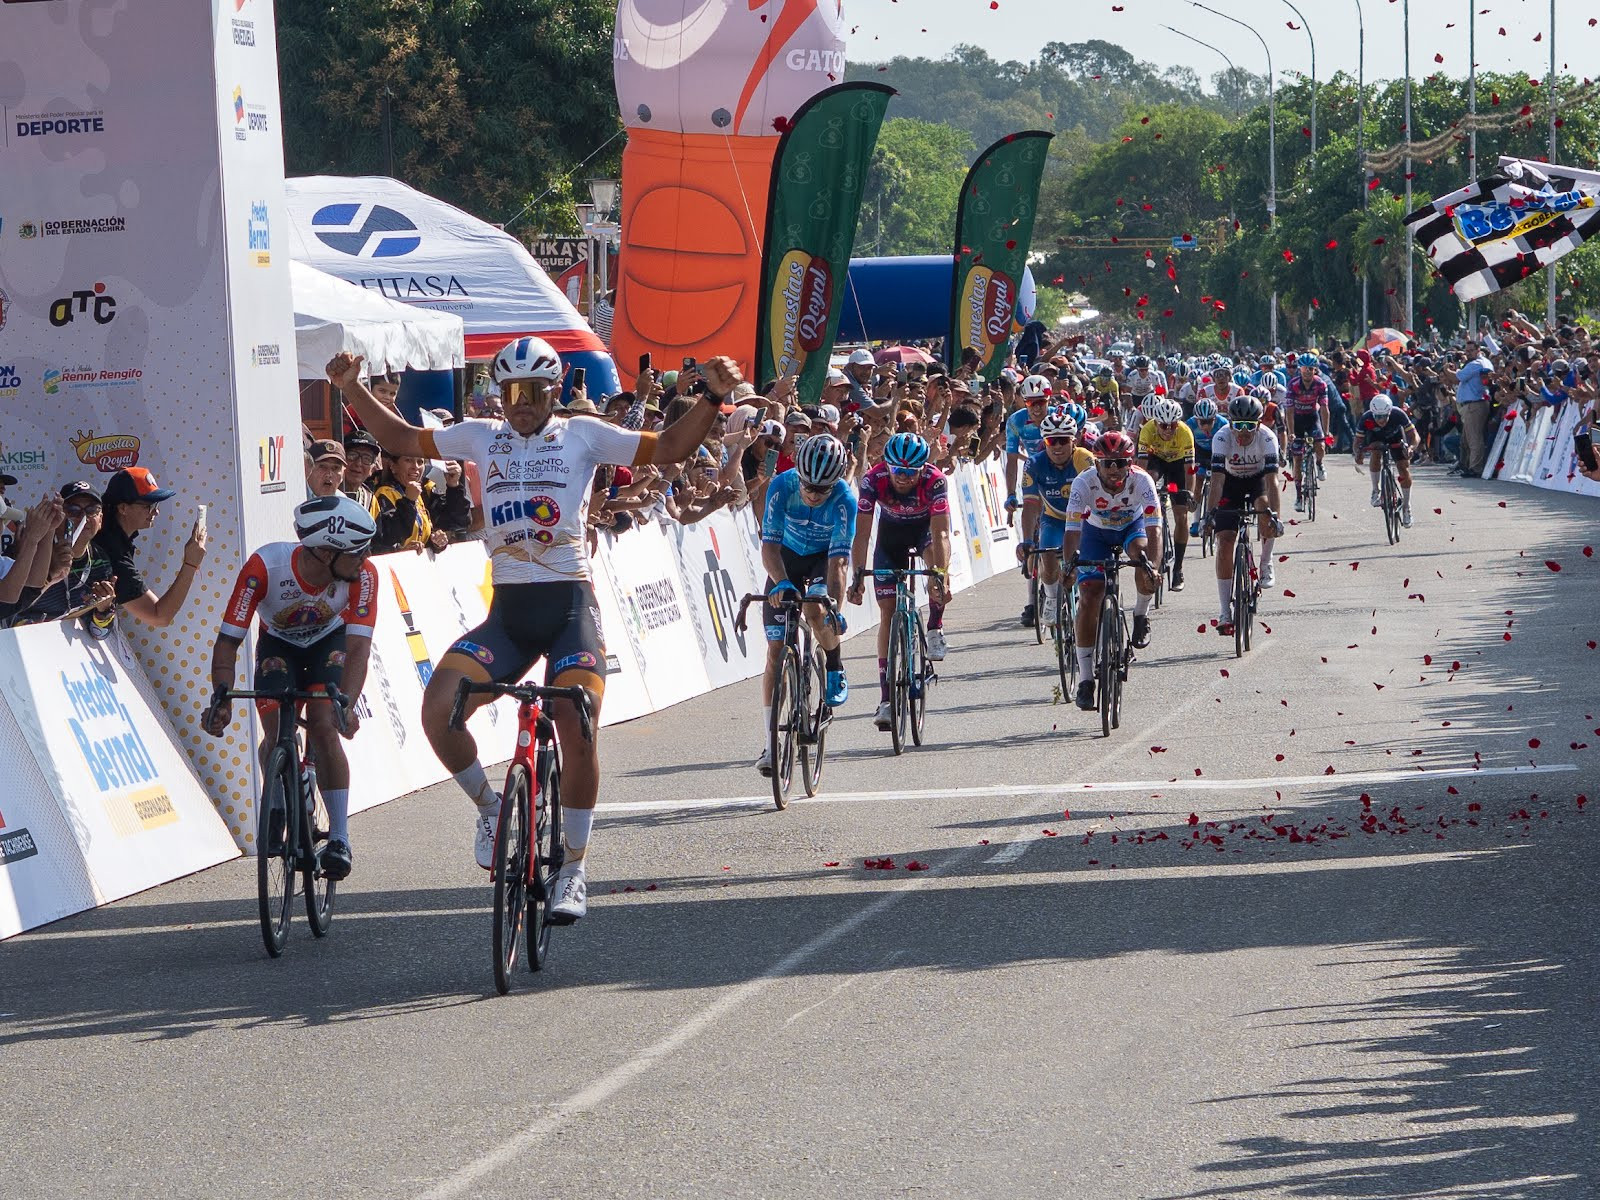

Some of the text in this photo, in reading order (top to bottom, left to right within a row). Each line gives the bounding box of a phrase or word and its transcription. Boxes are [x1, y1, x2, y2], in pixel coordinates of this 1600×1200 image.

[16, 117, 105, 137] DEPORTE
[45, 216, 126, 230] GOBERNACIÓN
[62, 227, 92, 235] ESTADO
[799, 266, 827, 340] Royal
[987, 279, 1012, 336] Royal
[62, 368, 143, 382] Renny Rengifo
[83, 437, 135, 461] Apuestas
[17, 463, 46, 471] LICORES
[100, 450, 133, 470] Royal
[327, 515, 345, 534] 82
[235, 586, 256, 622] TACHIRA
[65, 703, 159, 792] Bernal
